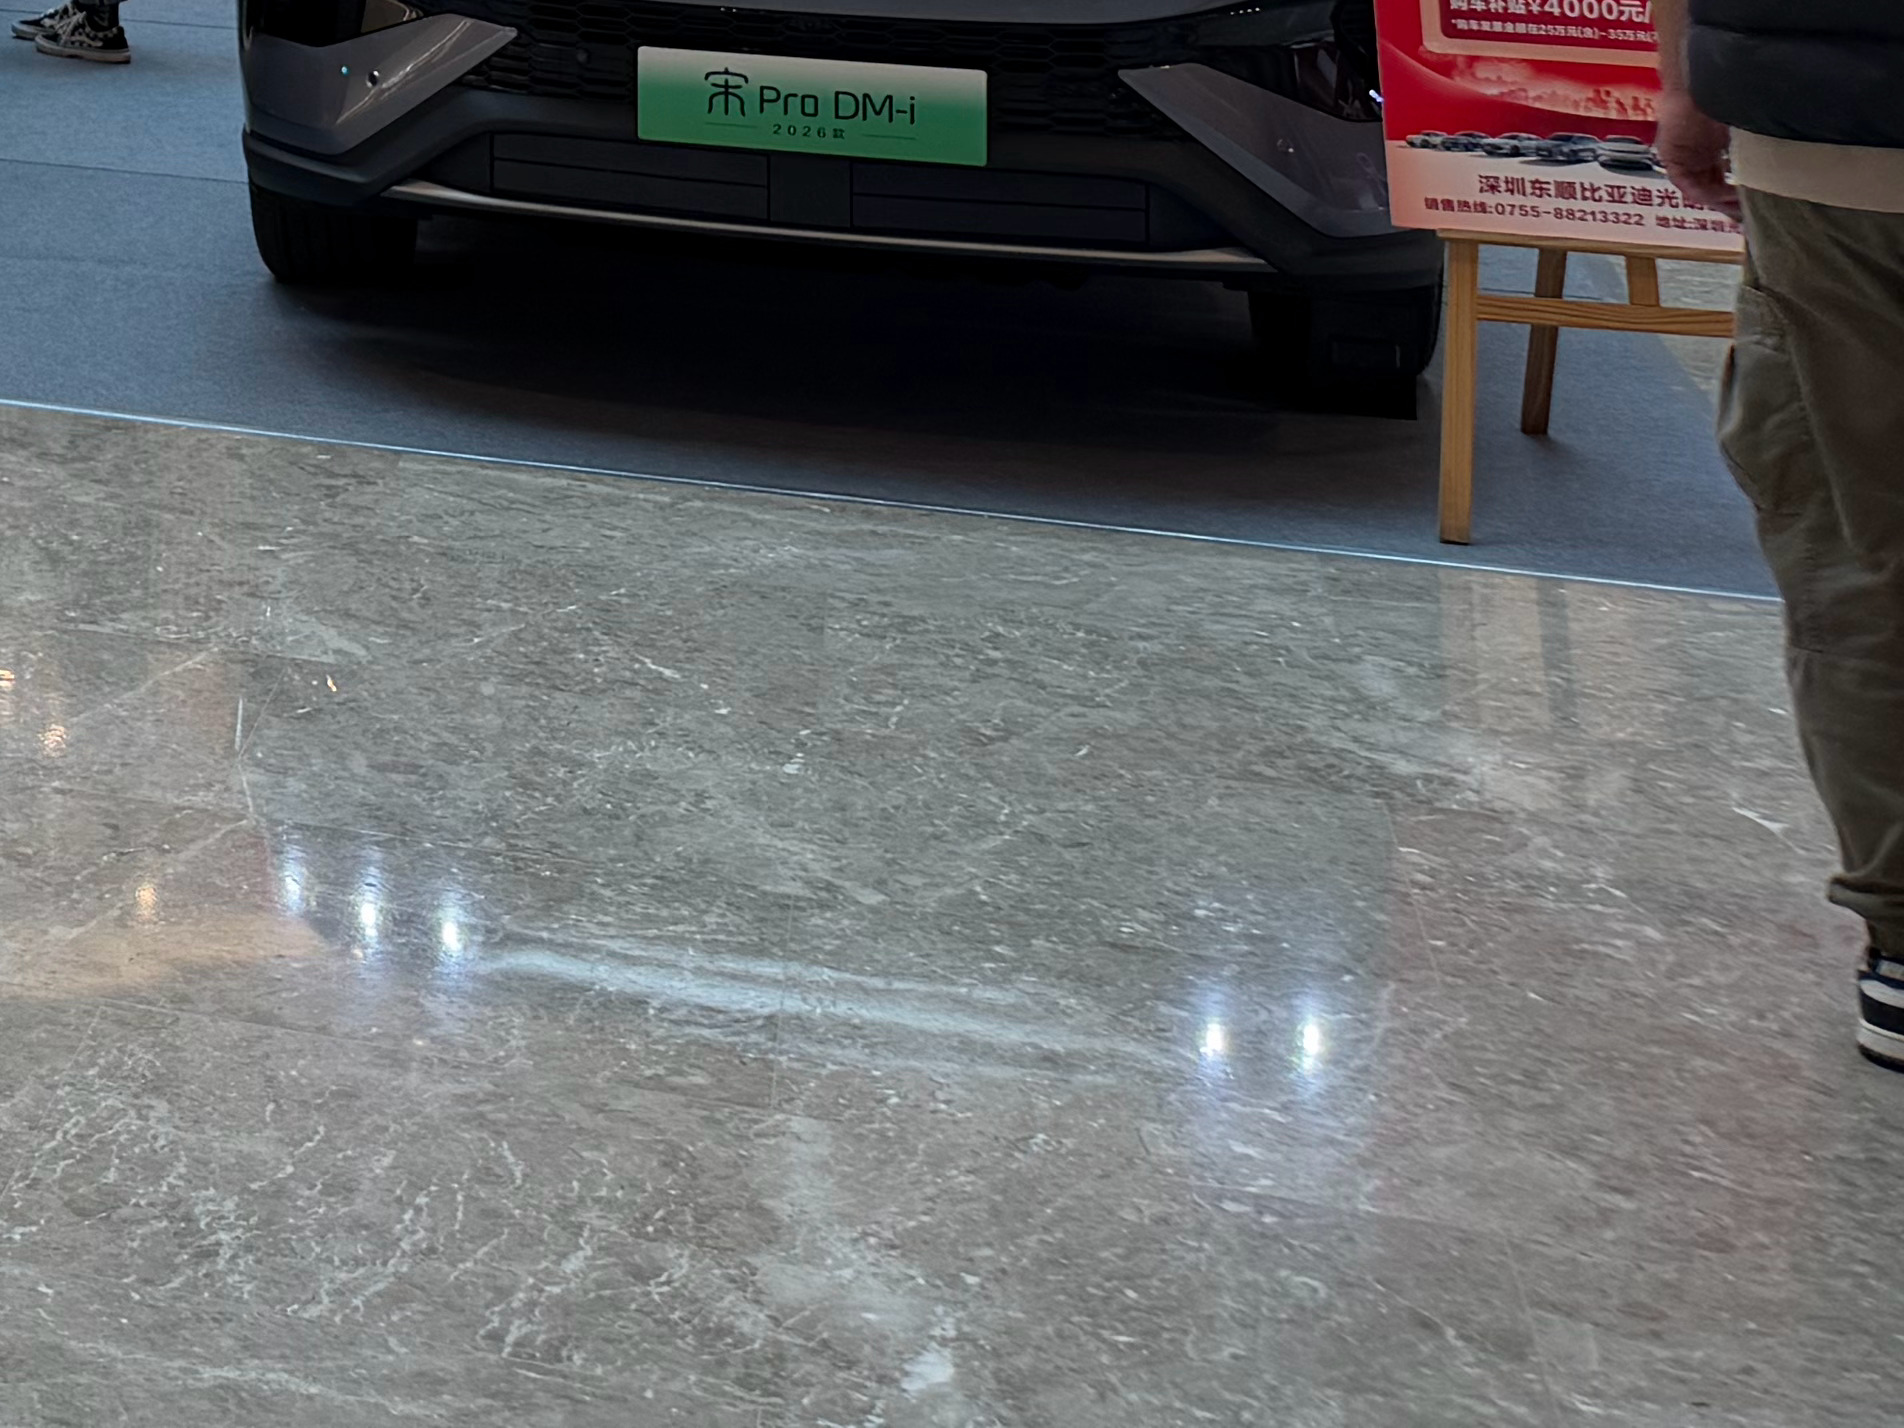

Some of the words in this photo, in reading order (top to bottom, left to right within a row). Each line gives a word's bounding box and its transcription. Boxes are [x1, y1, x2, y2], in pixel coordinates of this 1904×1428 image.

[834, 90, 917, 127] DM-i
[1478, 173, 1717, 211] 深圳东顺比亚迪光
